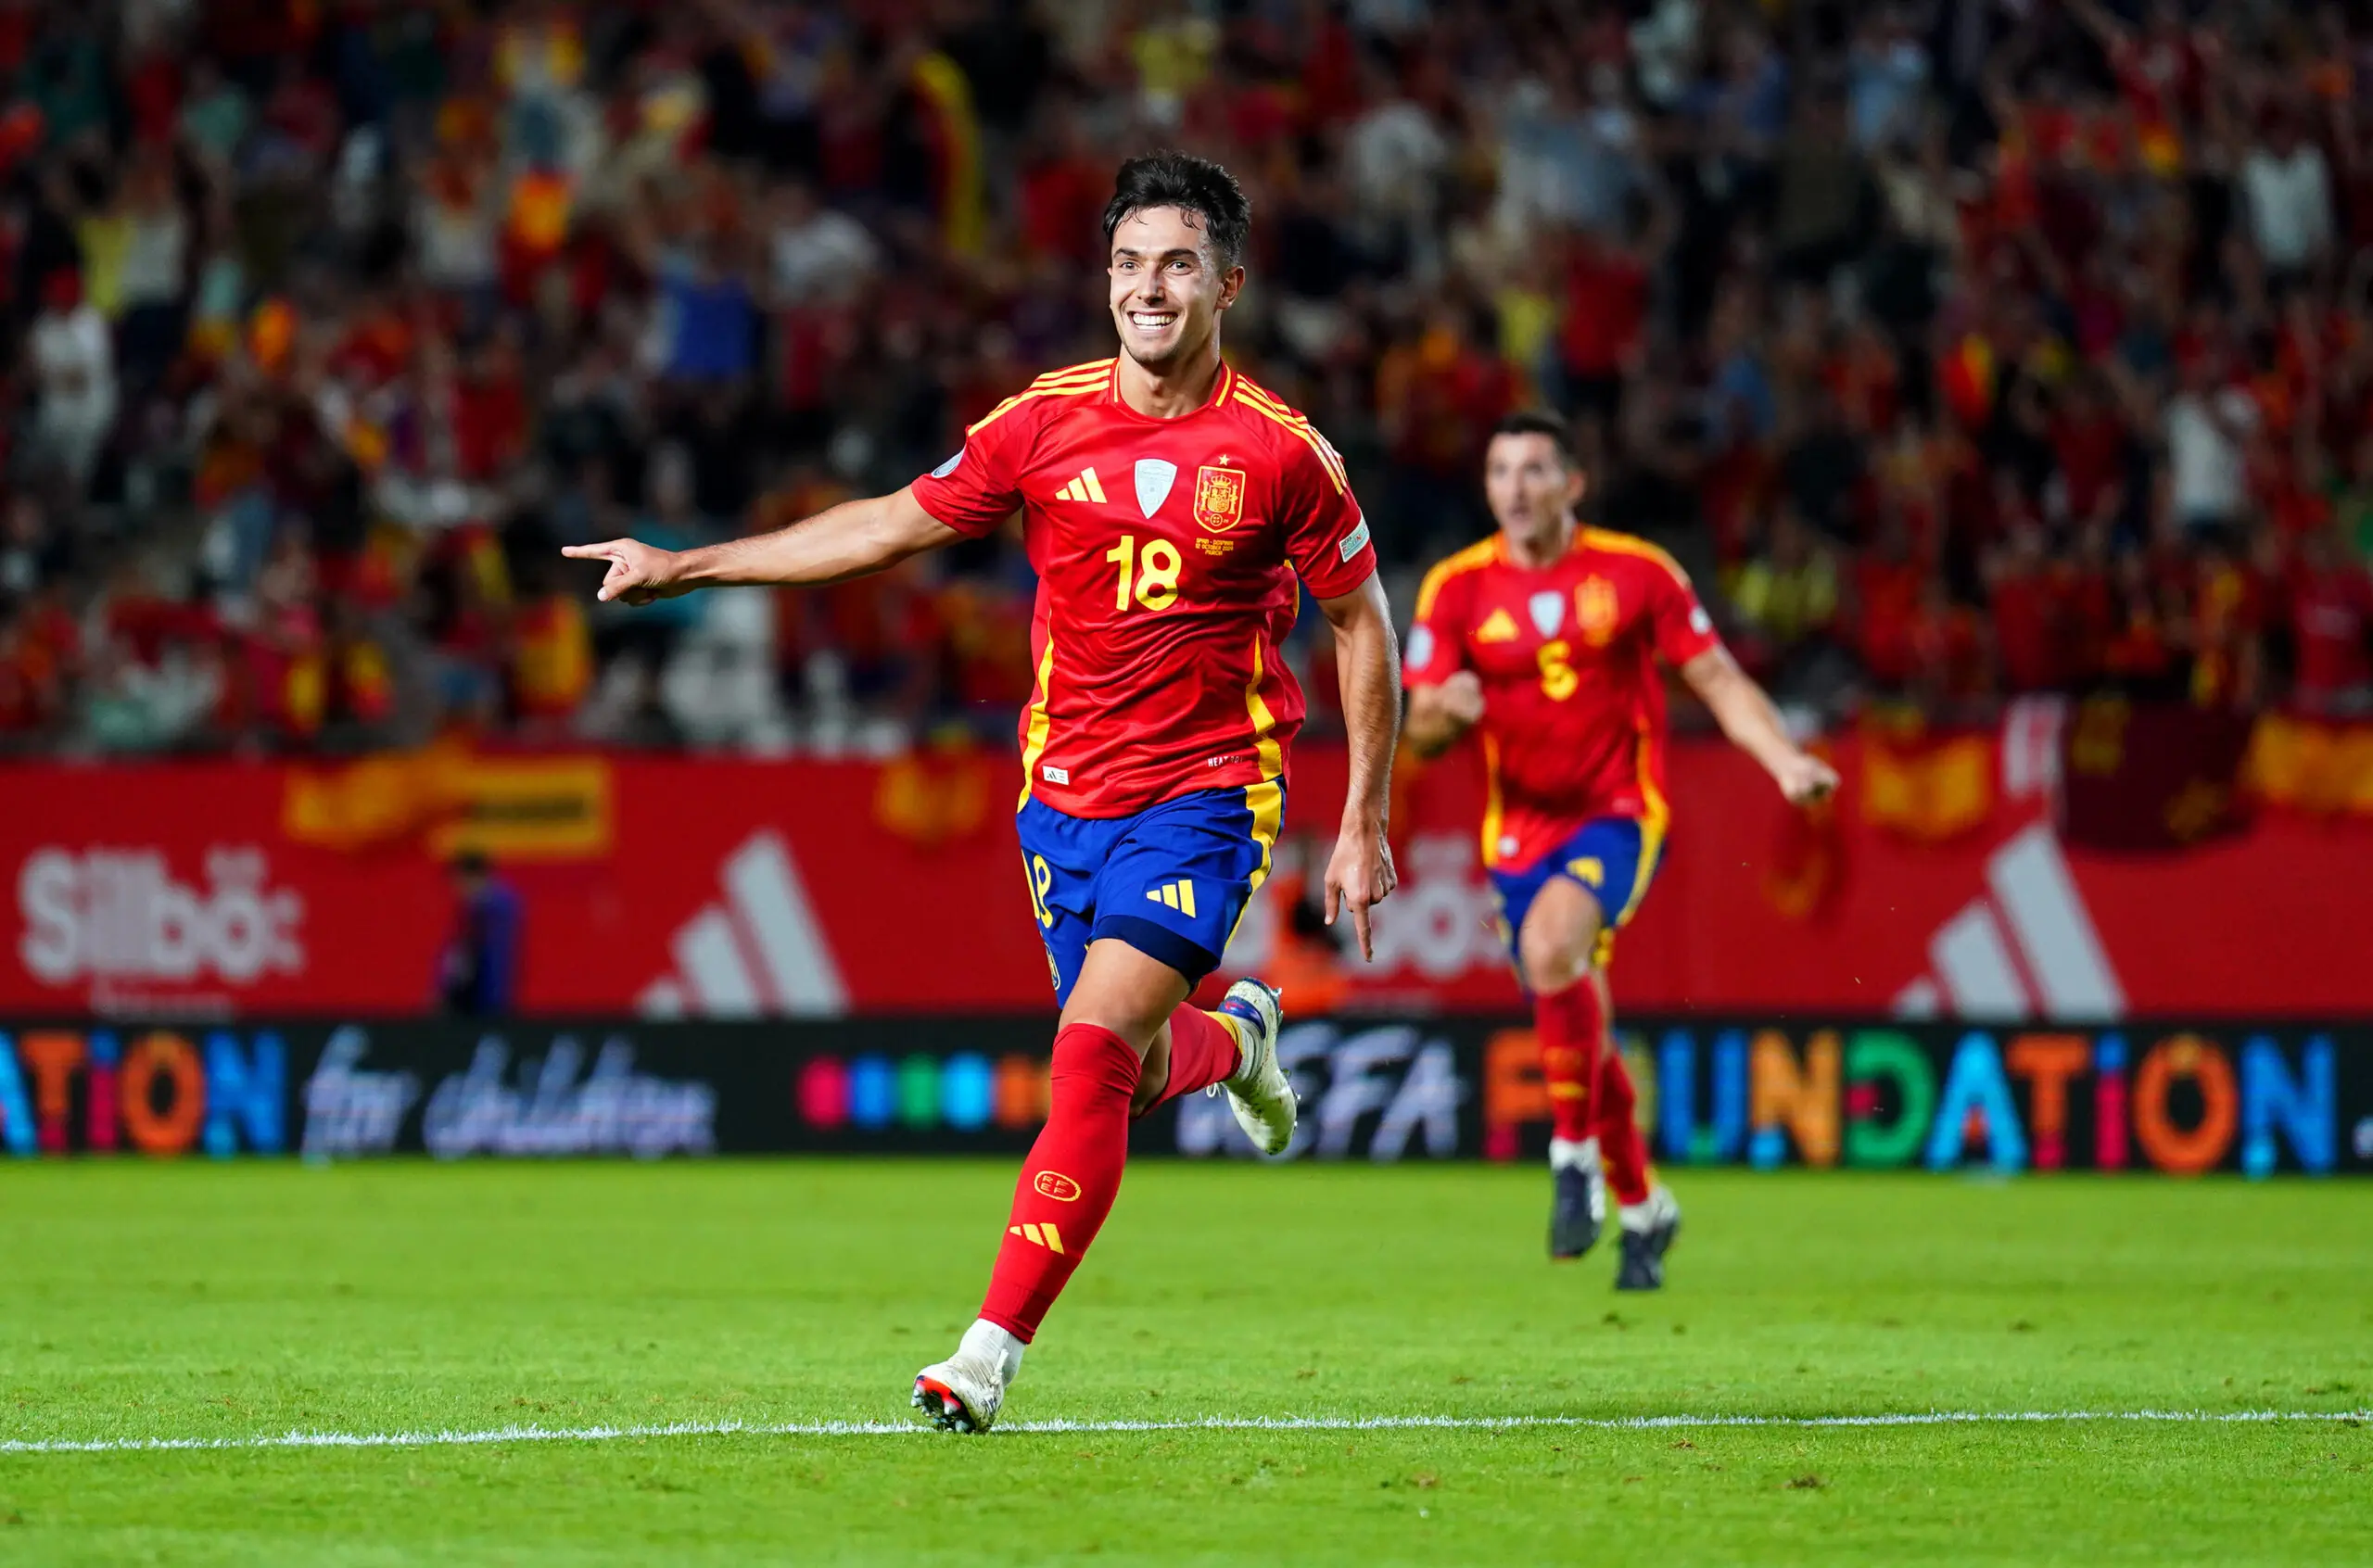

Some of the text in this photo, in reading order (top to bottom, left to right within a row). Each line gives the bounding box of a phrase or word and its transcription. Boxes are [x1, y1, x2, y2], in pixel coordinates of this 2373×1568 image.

[1106, 535, 1182, 612] 18
[1538, 639, 1580, 702] 5
[1208, 755, 1229, 767] HEAT
[1486, 1029, 2338, 1170] FUNDATION
